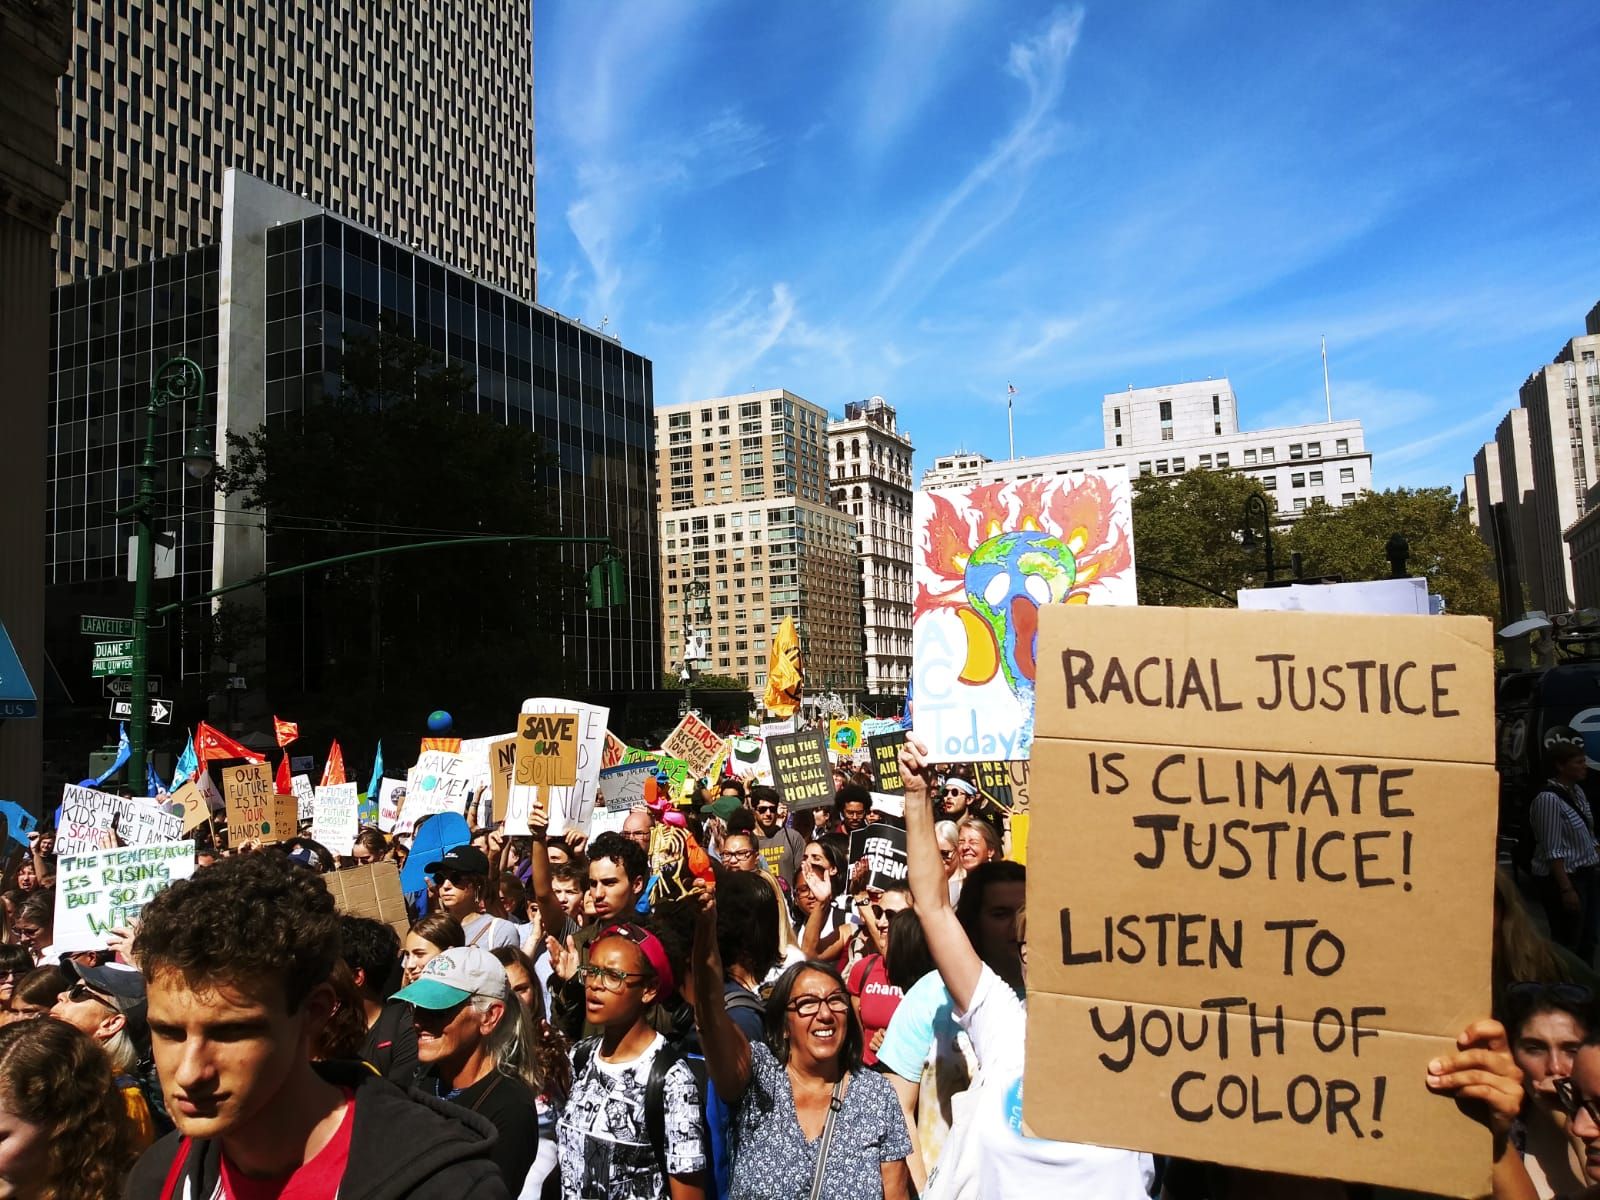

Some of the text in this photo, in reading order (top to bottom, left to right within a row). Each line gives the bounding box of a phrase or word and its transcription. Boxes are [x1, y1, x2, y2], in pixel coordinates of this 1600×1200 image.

[82, 619, 124, 633] LAFAYETTE
[96, 642, 131, 657] DUANE ST
[92, 661, 107, 671] PAUL
[1061, 648, 1460, 718] RACIAL JUSTICE
[522, 717, 575, 741] SAVE
[682, 715, 722, 753] PLEASE
[534, 740, 560, 756] OUR
[668, 737, 686, 757] YOUR
[675, 729, 712, 762] RECYCLE
[775, 739, 819, 756] FOR THE
[876, 746, 895, 760] FOR
[423, 755, 463, 775] SAVE
[517, 756, 572, 786] SOIL
[778, 753, 822, 769] PLACES
[879, 761, 898, 775] AIR
[235, 768, 261, 782] OUR
[781, 768, 825, 784] WE CALL
[1089, 752, 1129, 795] IS
[1152, 754, 1414, 818] CLIMATE
[230, 780, 269, 798] FUTURE
[784, 782, 829, 802] HOME
[64, 787, 136, 823] MARCHING
[235, 796, 268, 809] IS IN
[62, 803, 97, 828] KIDS
[242, 808, 266, 822] YOUR
[229, 823, 260, 841] HANDS
[864, 837, 893, 857] FEEL
[1133, 814, 1413, 892] JUSTICE!
[61, 856, 98, 872] THE
[63, 863, 170, 892] IS RISING
[67, 890, 103, 909] BUT
[109, 888, 137, 905] SO
[1060, 908, 1345, 976] LISTEN TO
[1090, 997, 1386, 1072] YOUTH OF
[1171, 1071, 1387, 1140] COLOR!
